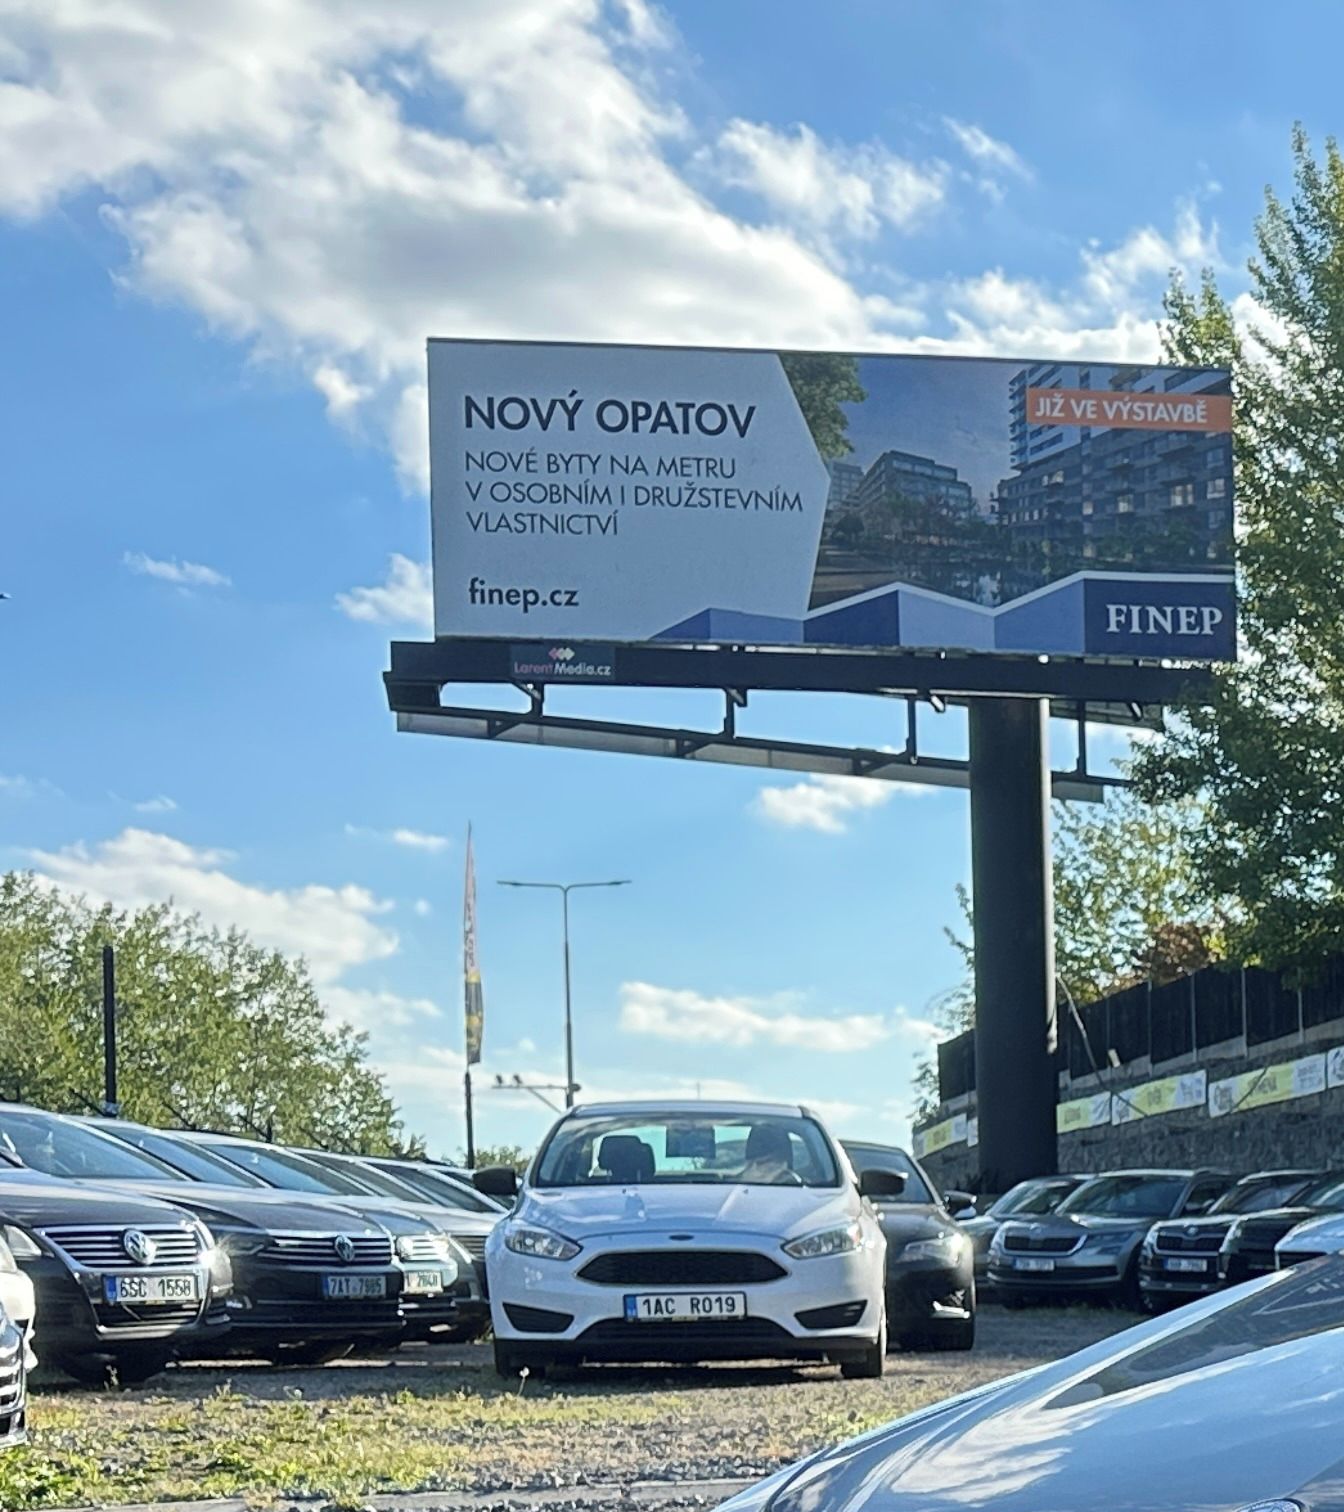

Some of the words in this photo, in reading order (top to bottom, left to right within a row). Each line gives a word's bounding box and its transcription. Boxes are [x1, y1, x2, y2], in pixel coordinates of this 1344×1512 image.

[464, 389, 584, 431] NOVÝ
[596, 399, 757, 438] OPATOV
[1035, 393, 1065, 418] JIŽ
[1070, 398, 1098, 419] VE
[466, 447, 538, 474] NOVÉ
[547, 452, 602, 475] BYTY
[610, 454, 649, 476] NA
[656, 456, 736, 479] METRU
[465, 481, 483, 503] V
[489, 478, 612, 506] OSOBNÍM
[619, 485, 626, 506] I
[634, 482, 803, 512] DRUŽSTEVNÍM
[466, 509, 619, 536] VLASTNICTVÍ
[469, 576, 580, 614] finep.cz
[1106, 604, 1223, 636] FINEP
[643, 1297, 676, 1316] 1AC
